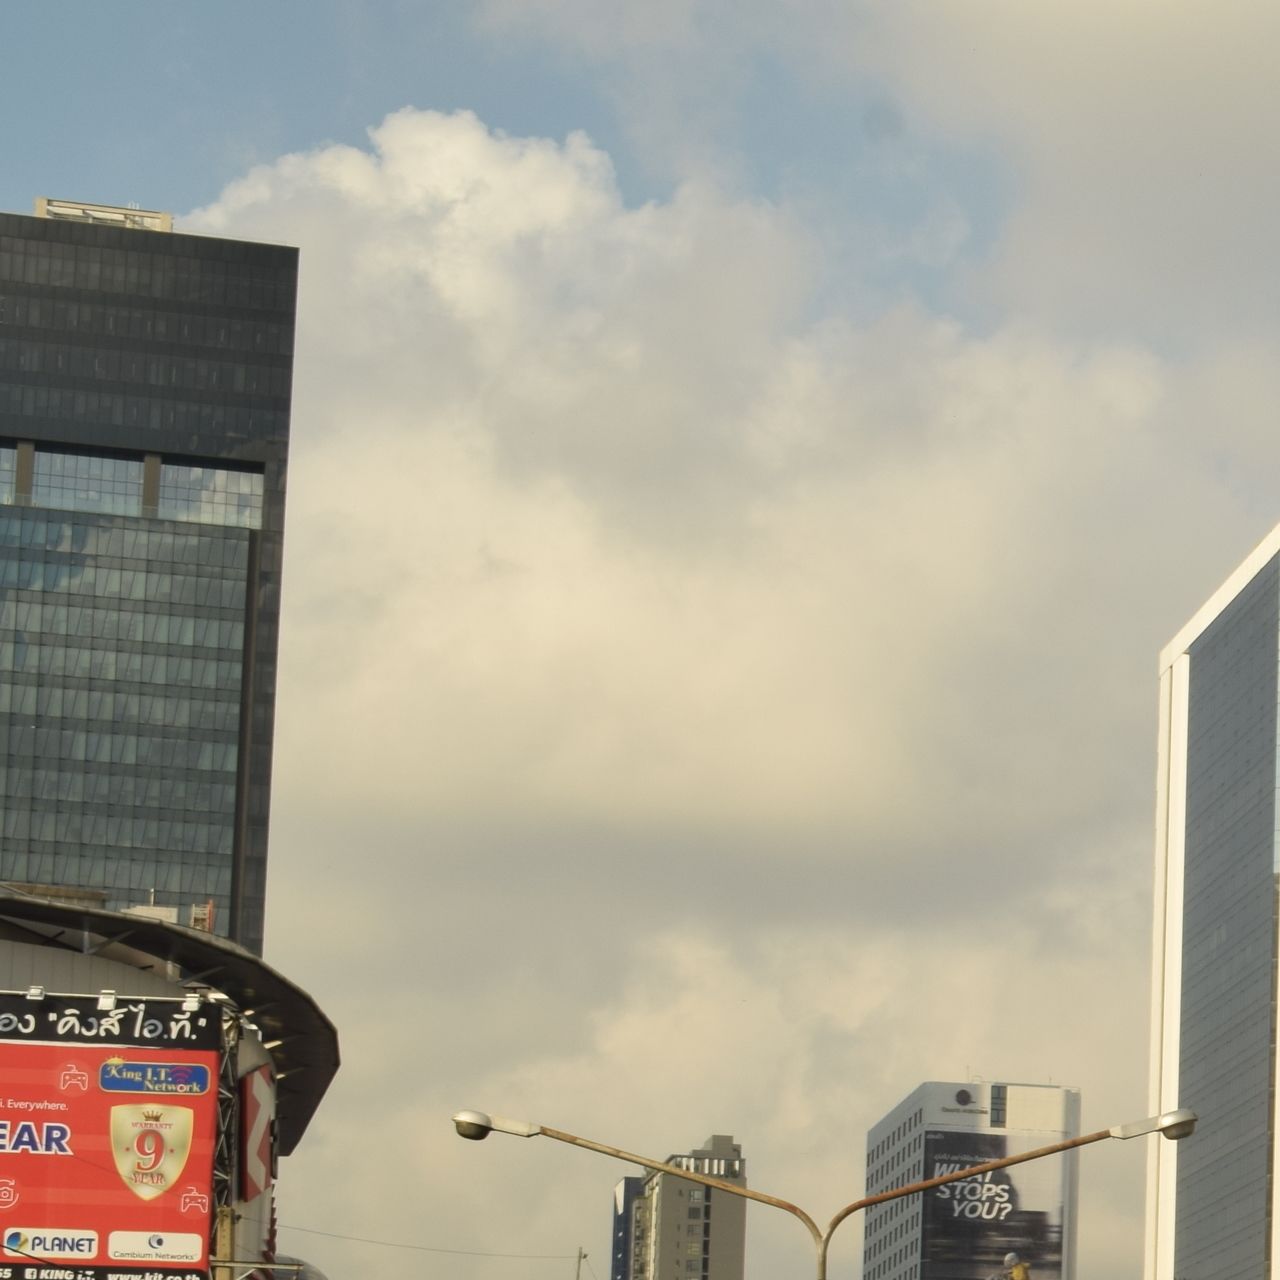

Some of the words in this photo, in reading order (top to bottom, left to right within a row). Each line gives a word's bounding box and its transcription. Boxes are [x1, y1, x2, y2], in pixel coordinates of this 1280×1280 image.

[105, 1065, 142, 1081] King
[146, 1067, 173, 1081] I.T.
[144, 1080, 201, 1093] Network
[7, 1099, 69, 1112] Everywhere.
[134, 1129, 165, 1174] 9
[132, 1173, 165, 1185] YEAR
[936, 1182, 1010, 1202] STOPS
[953, 1200, 1012, 1220] YOU?
[32, 1236, 96, 1253] PLANET
[114, 1251, 153, 1259] Cambium
[155, 1252, 195, 1261] Networks
[39, 1269, 75, 1280] KING
